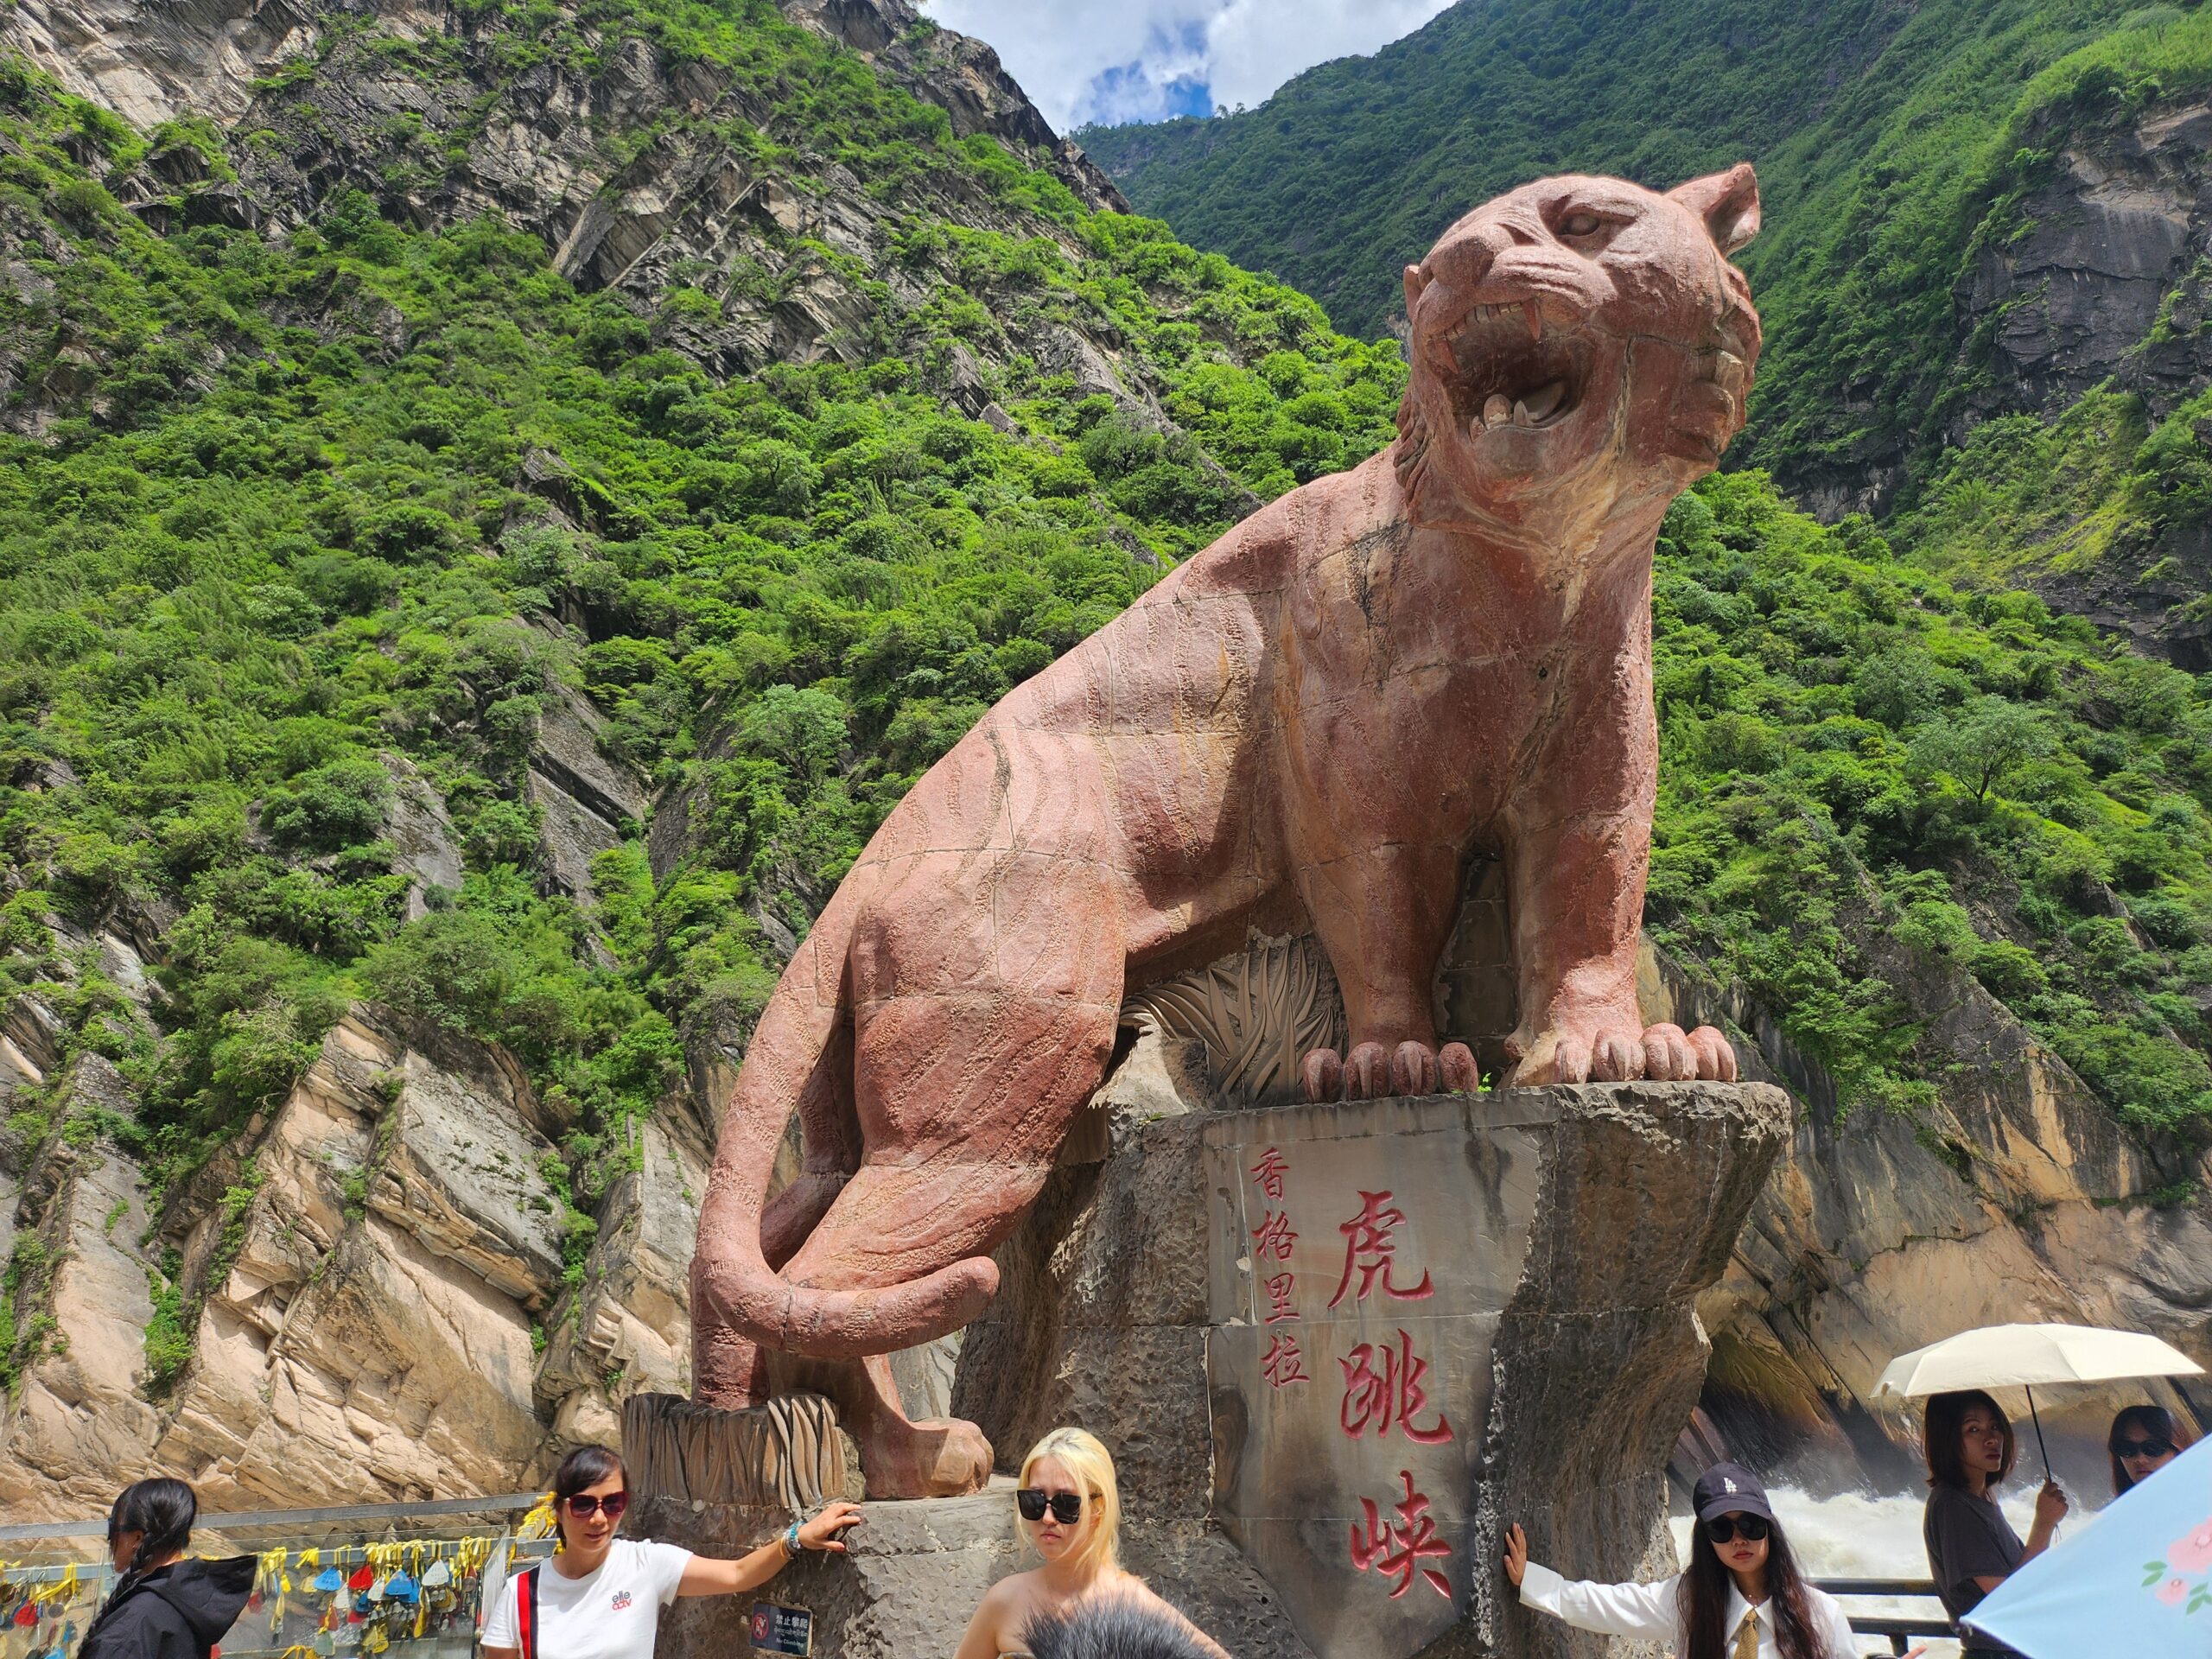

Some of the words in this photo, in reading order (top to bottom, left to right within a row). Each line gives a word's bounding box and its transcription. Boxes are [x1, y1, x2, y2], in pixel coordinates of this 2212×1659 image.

[1250, 1146, 1311, 1389] 香格里拉
[1327, 1189, 1455, 1600] 虎跳峡
[612, 1590, 631, 1603] elle
[775, 1614, 808, 1629] 禁止攀爬
